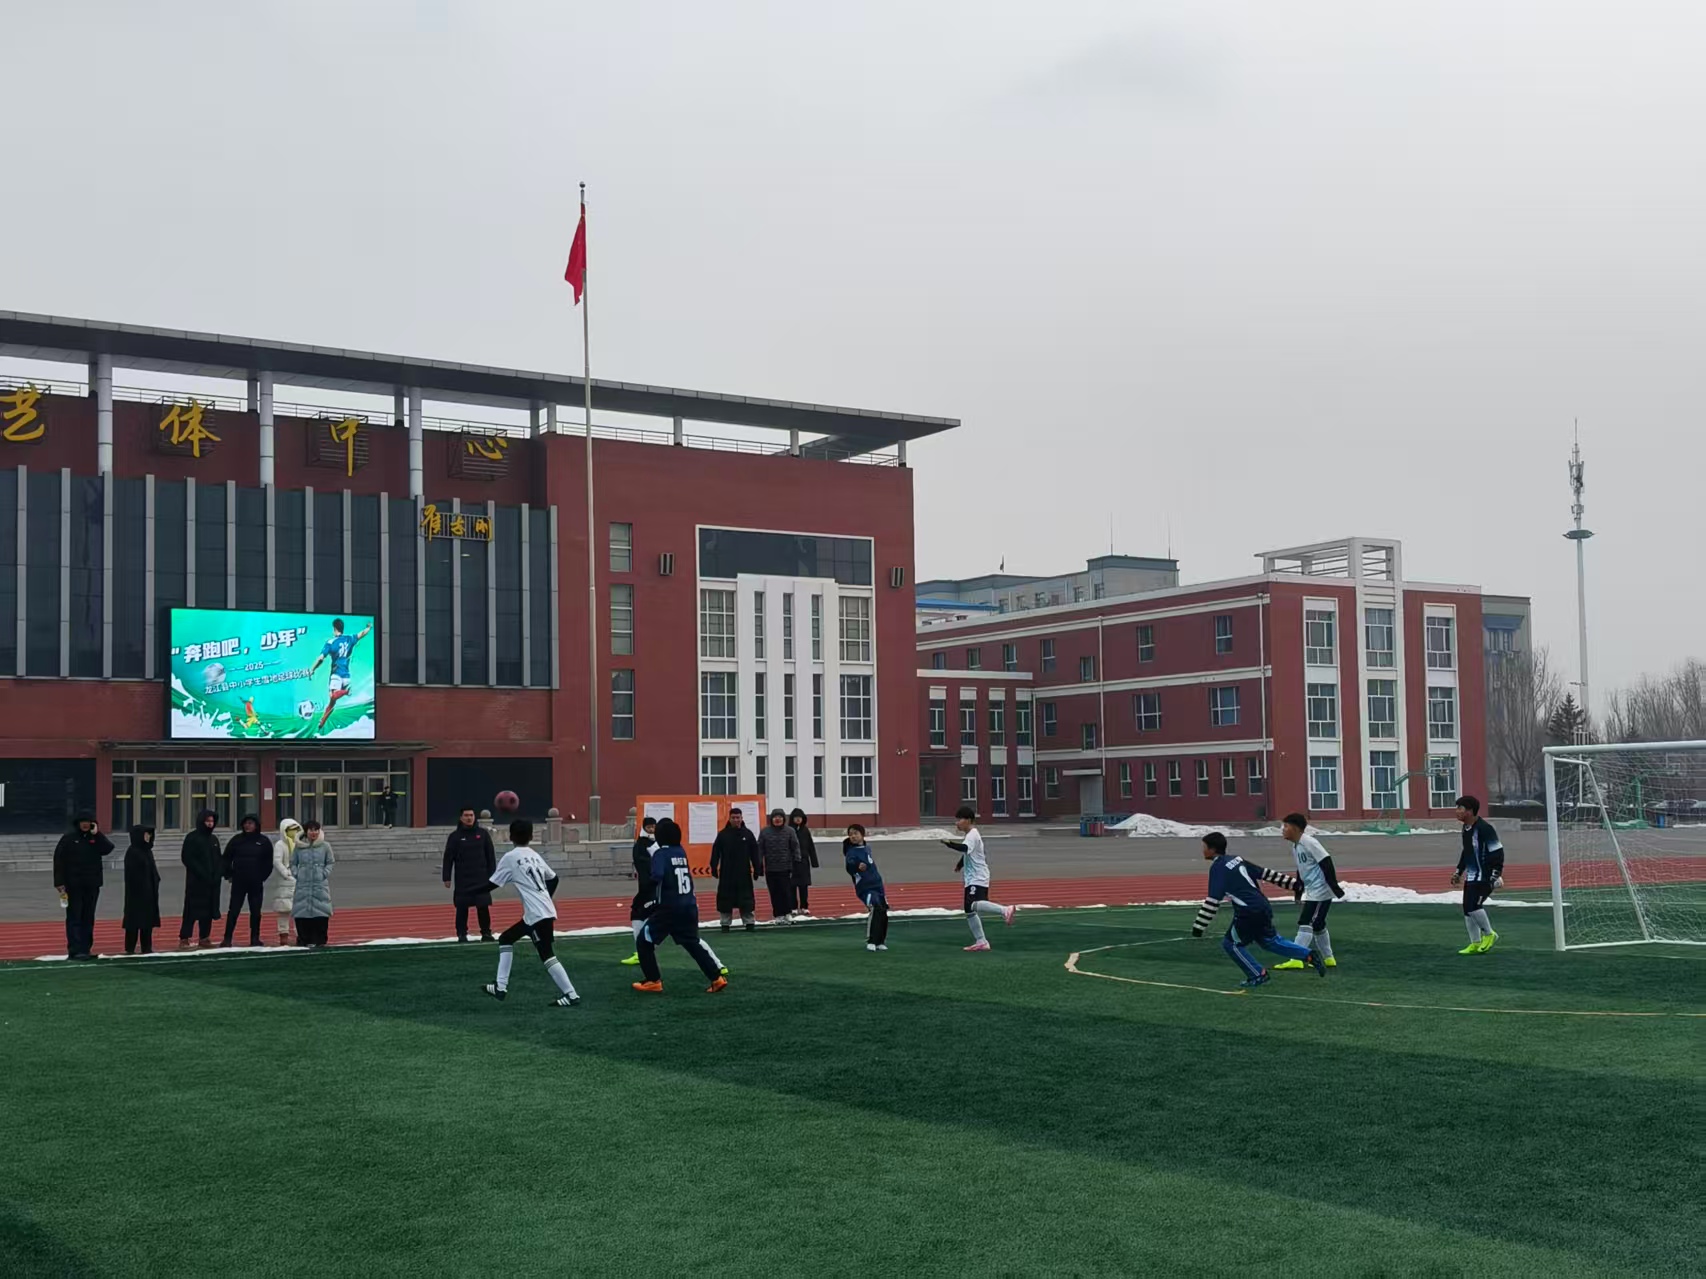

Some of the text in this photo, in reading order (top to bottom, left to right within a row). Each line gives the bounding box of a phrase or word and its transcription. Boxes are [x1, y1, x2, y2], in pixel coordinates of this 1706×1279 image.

[0, 382, 508, 477] 艺体中心
[674, 867, 691, 895] 15
